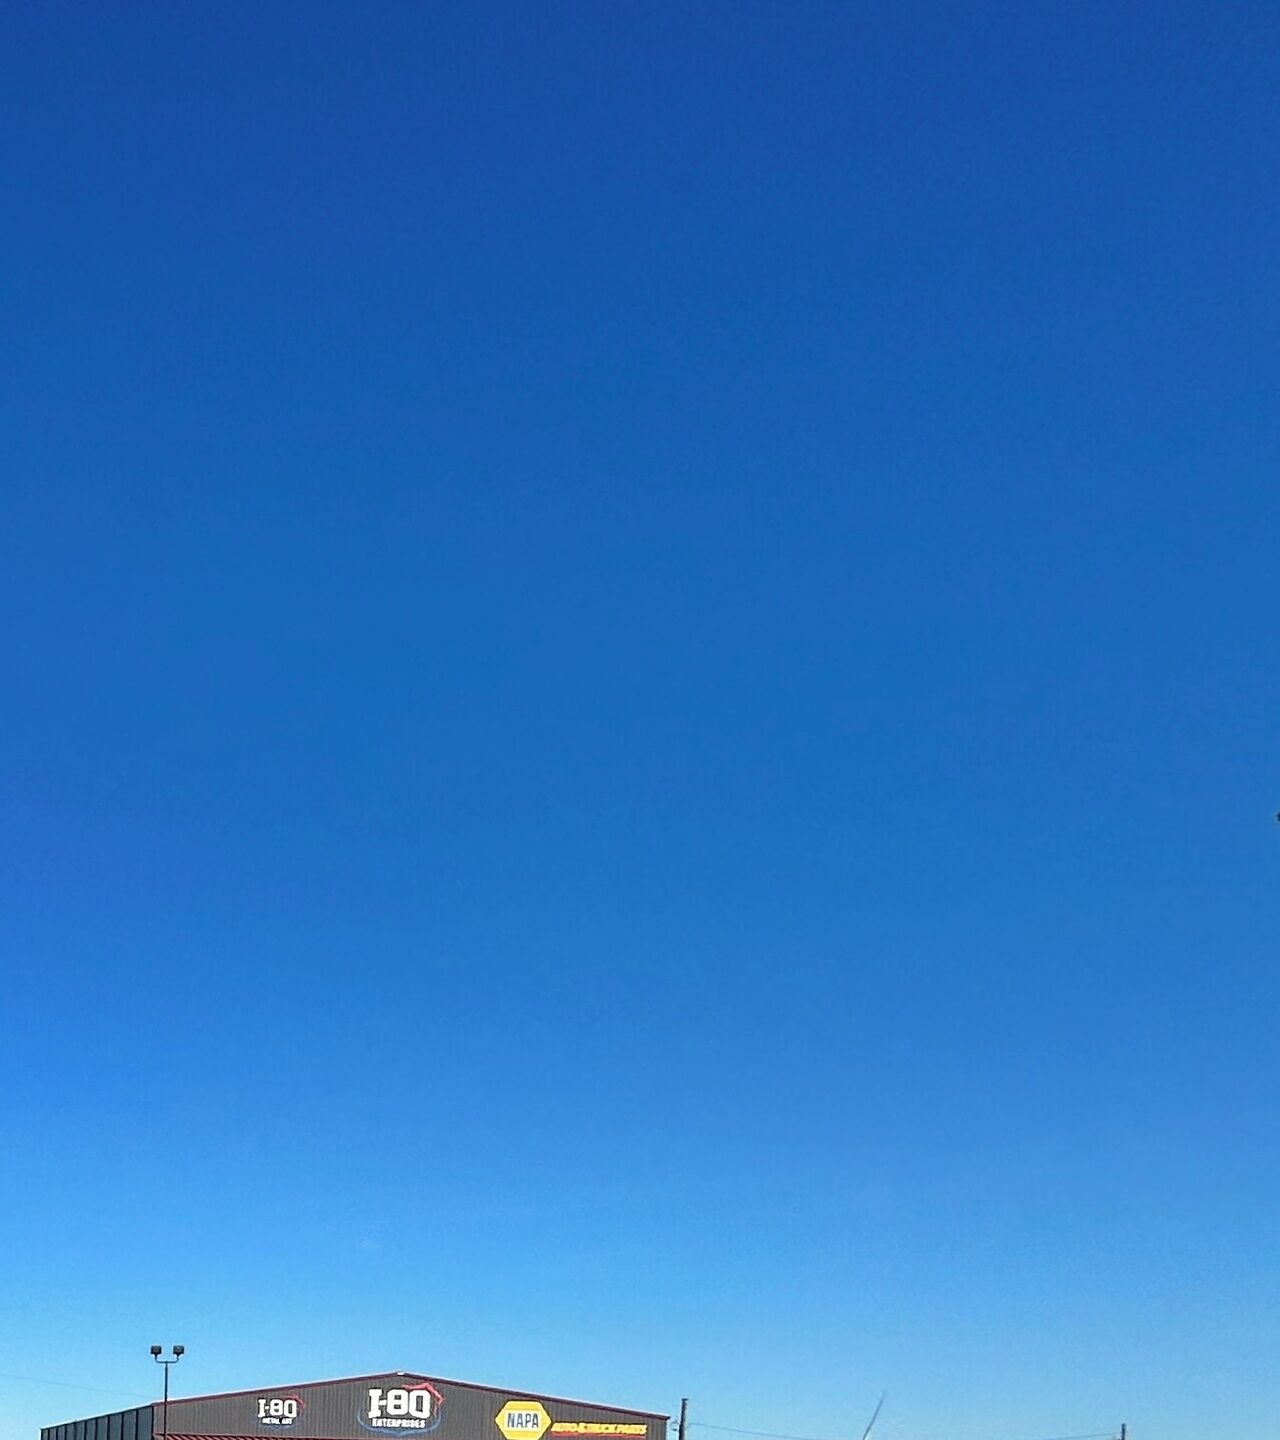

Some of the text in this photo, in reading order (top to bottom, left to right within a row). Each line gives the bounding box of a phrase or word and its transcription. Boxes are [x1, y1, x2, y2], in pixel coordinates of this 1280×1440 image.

[257, 1398, 297, 1418] I-80
[368, 1388, 431, 1419] I-80
[507, 1412, 539, 1428] NAPA
